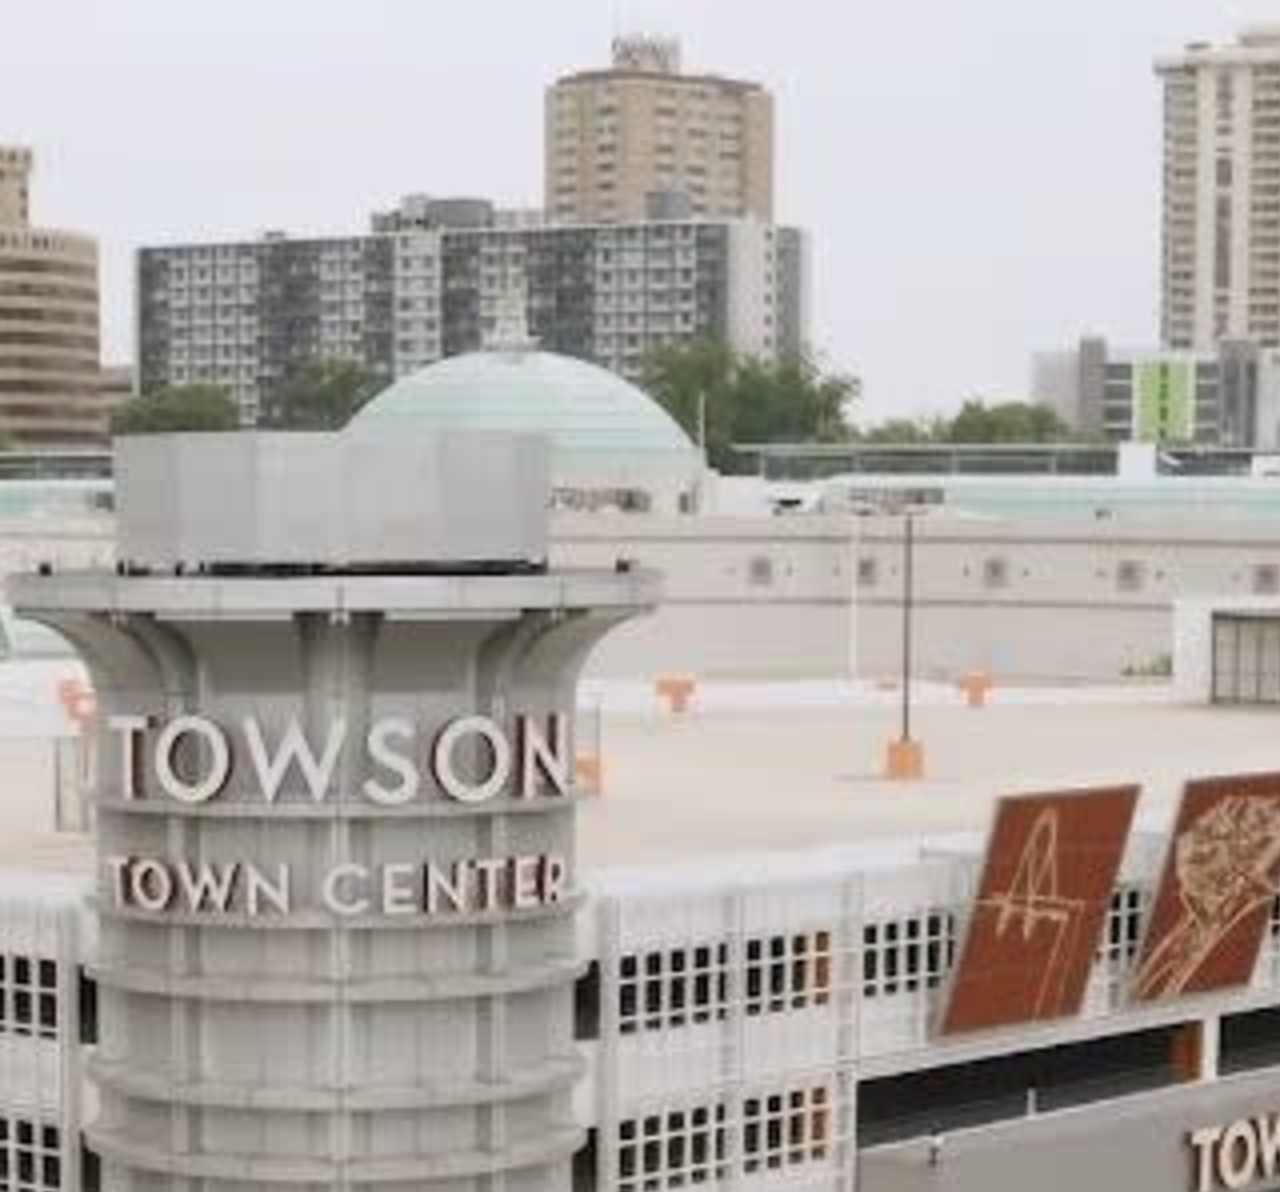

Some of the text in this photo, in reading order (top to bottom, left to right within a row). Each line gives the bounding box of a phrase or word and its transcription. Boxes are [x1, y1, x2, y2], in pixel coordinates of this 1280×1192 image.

[108, 713, 574, 803] TOWSON
[107, 853, 568, 915] TOWN CENTER
